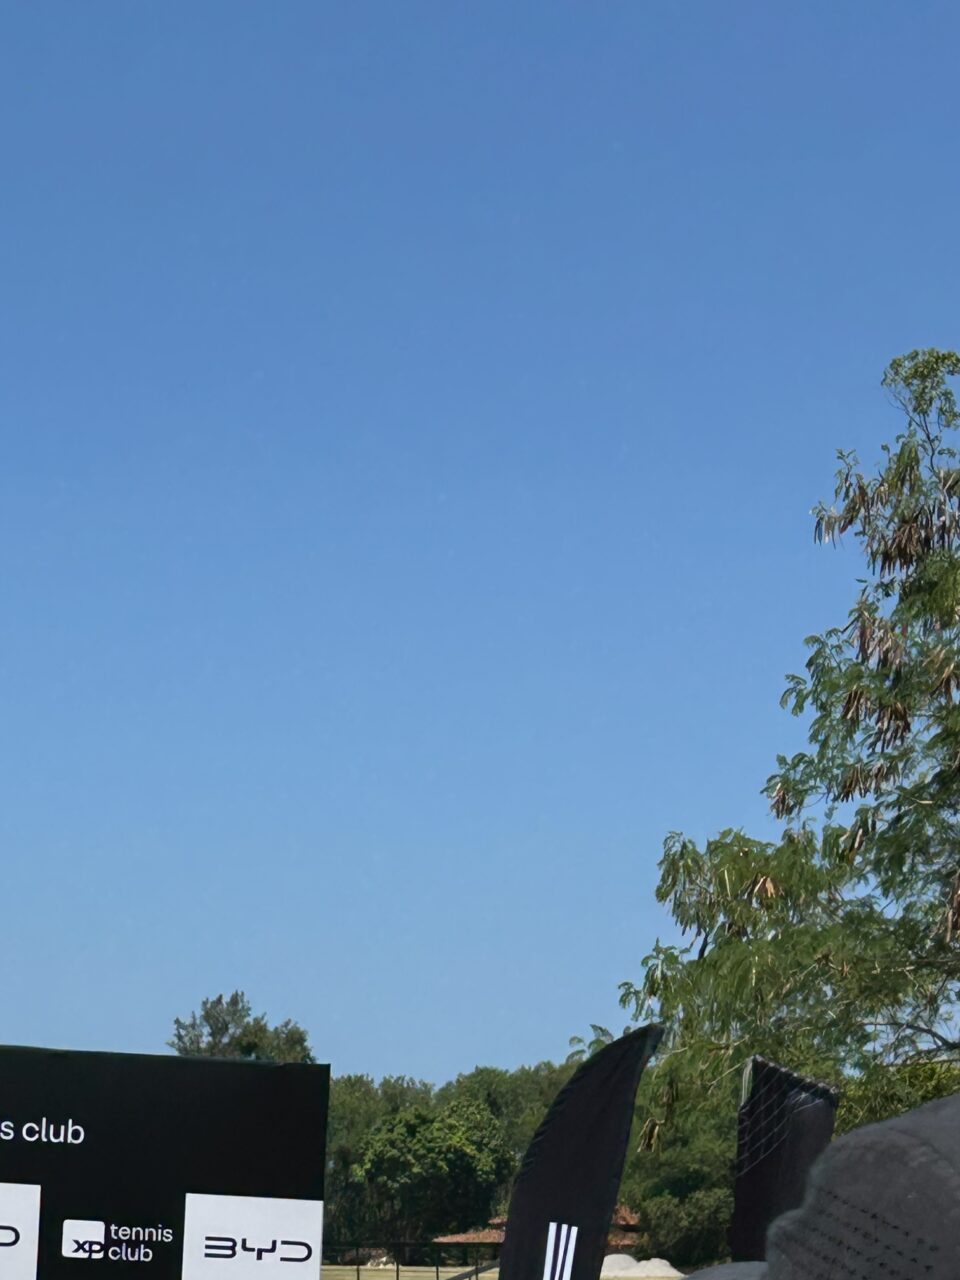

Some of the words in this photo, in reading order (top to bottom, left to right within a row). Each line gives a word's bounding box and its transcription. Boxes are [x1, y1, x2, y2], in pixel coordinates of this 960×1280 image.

[22, 1118, 84, 1144] club
[110, 1224, 173, 1242] tennis
[109, 1243, 152, 1261] club
[205, 1237, 312, 1262] BYD
